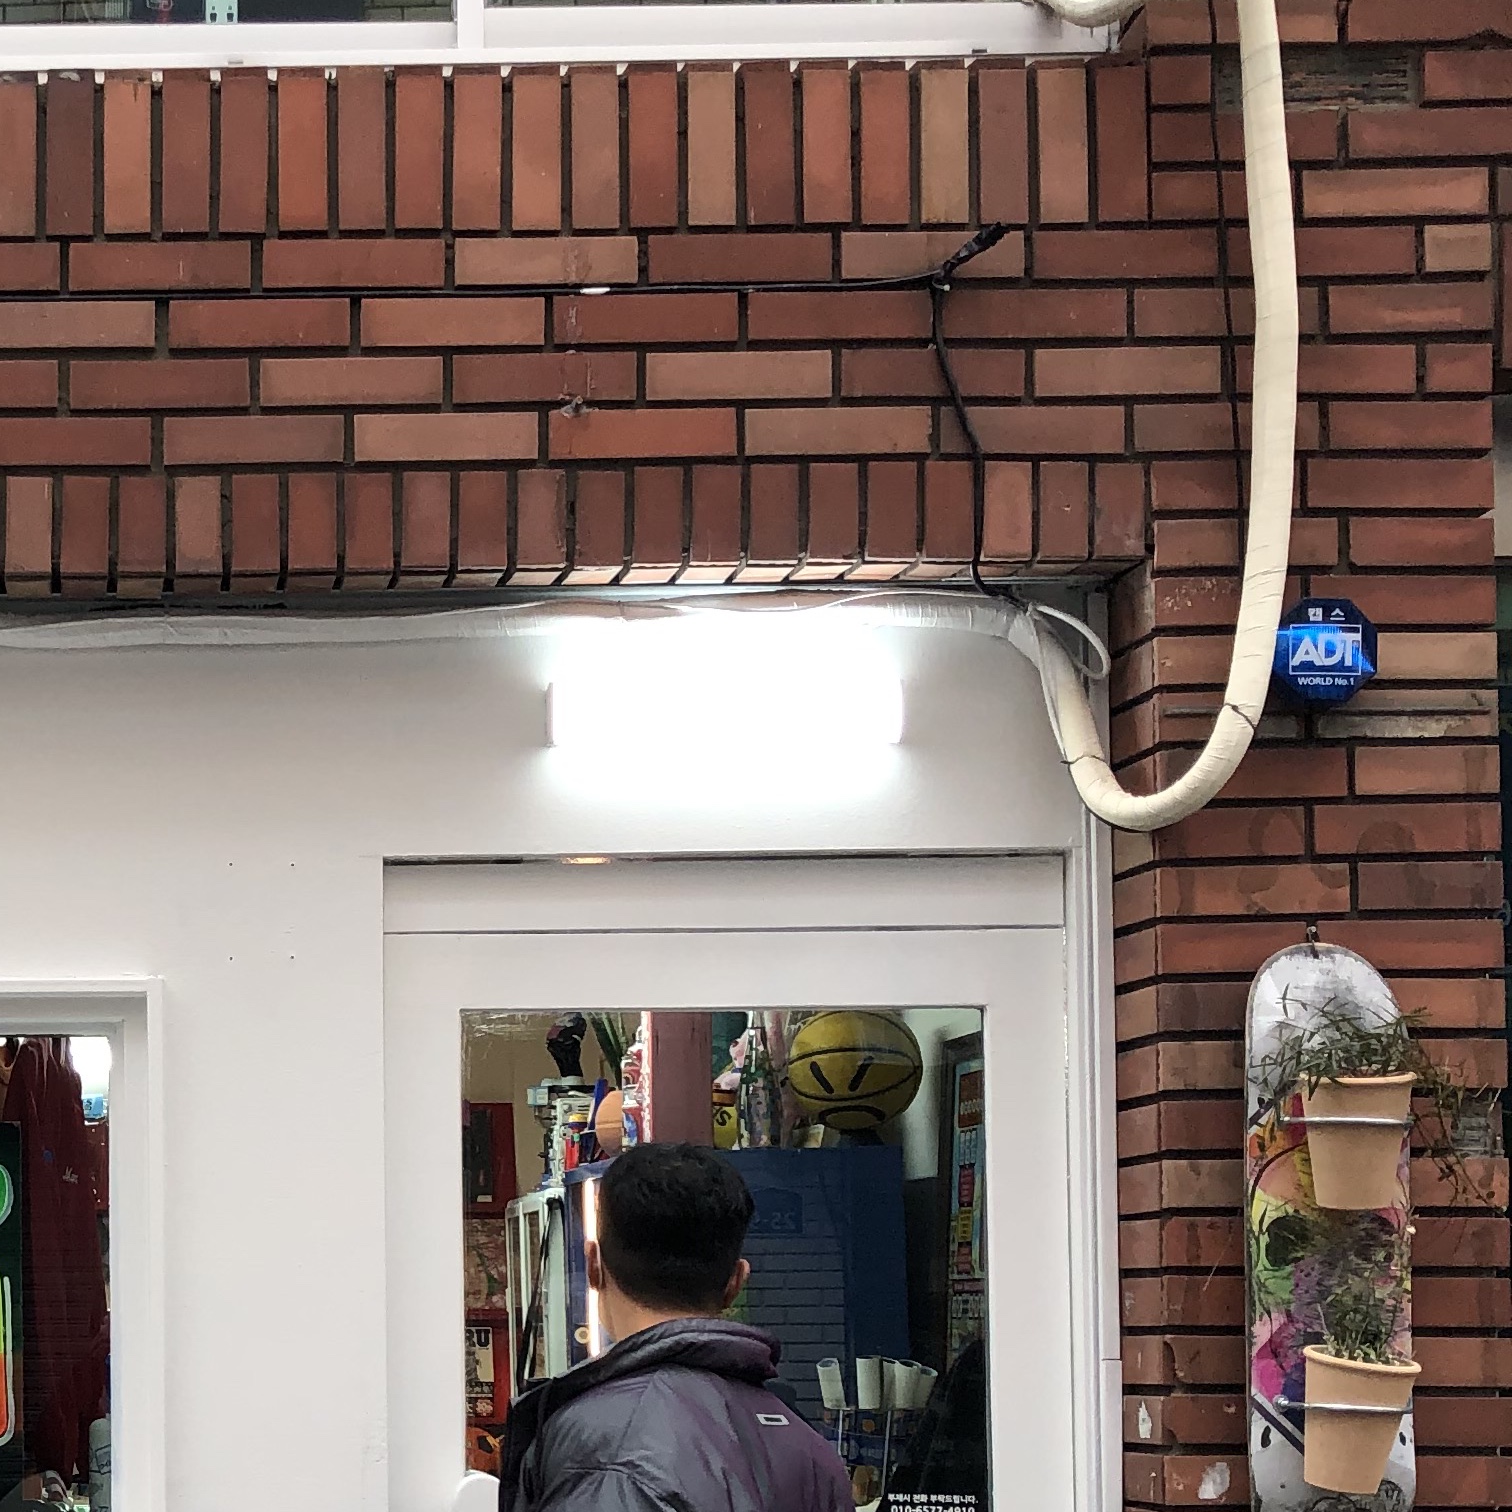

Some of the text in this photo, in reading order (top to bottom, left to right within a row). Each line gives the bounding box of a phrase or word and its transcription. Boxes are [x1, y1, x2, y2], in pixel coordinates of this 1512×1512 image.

[1308, 607, 1346, 621] 캡스
[1291, 632, 1361, 666] ADT
[1298, 677, 1333, 686] WORLD
